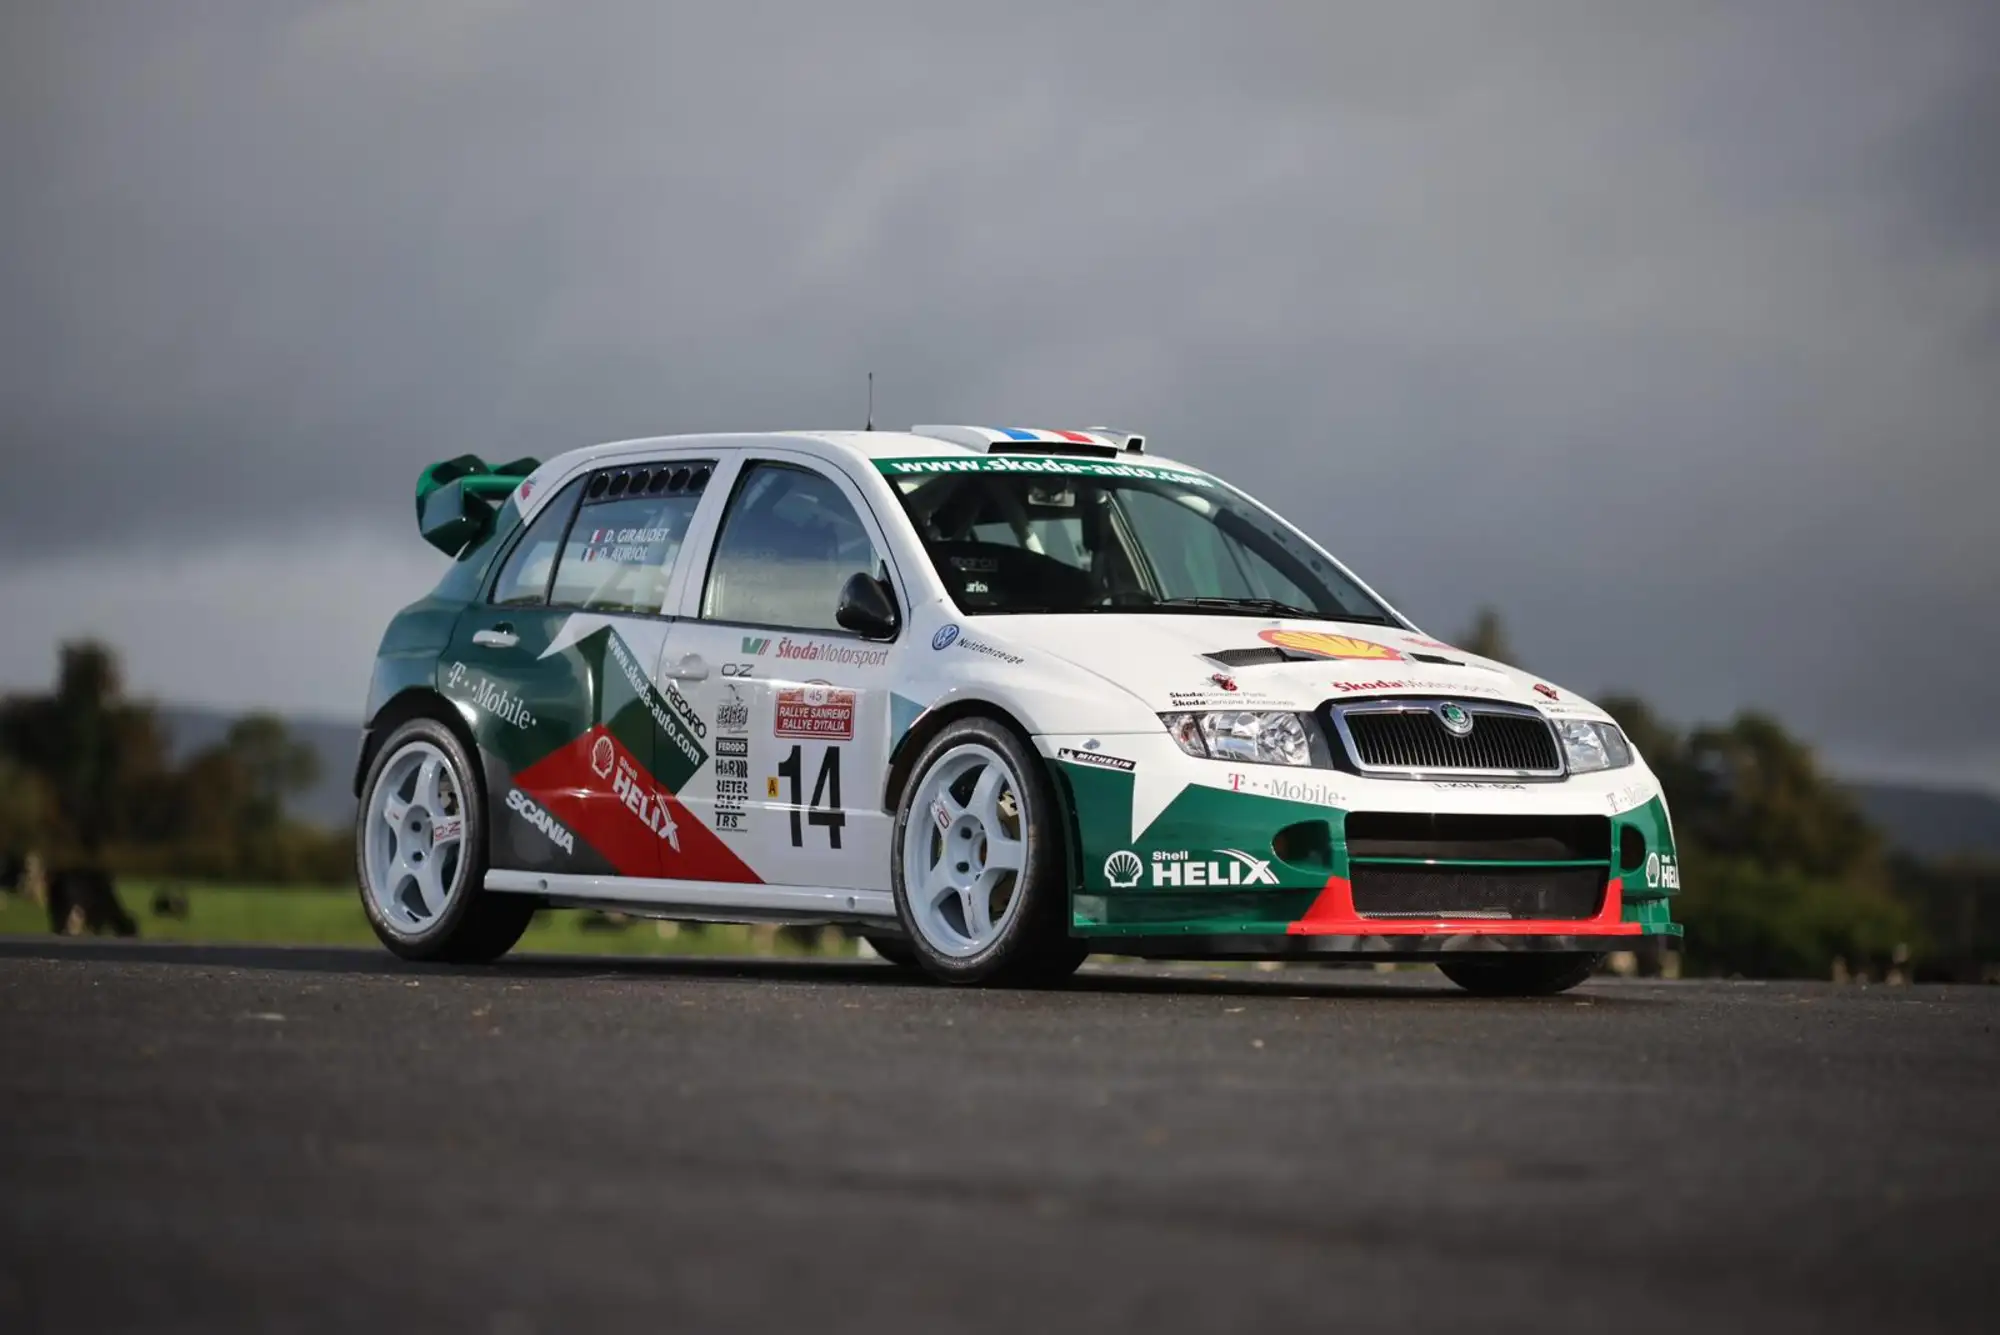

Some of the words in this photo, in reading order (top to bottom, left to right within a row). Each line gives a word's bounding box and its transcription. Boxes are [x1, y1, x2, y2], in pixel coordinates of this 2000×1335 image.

[891, 458, 1213, 488] www.skoda-auto.com
[606, 630, 701, 766] www.skoda-auto.com
[665, 685, 708, 740] RECARO
[809, 689, 822, 702] 45
[779, 706, 809, 718] RALLYE
[811, 708, 850, 720] SANREMO
[782, 718, 812, 730] RALLYE
[1077, 752, 1132, 769] MICHELIN
[612, 767, 680, 853] HELIX
[778, 745, 845, 849] 14
[505, 789, 574, 855] SCANIA
[1151, 848, 1280, 886] HELIX
[1152, 851, 1188, 861] Shell
